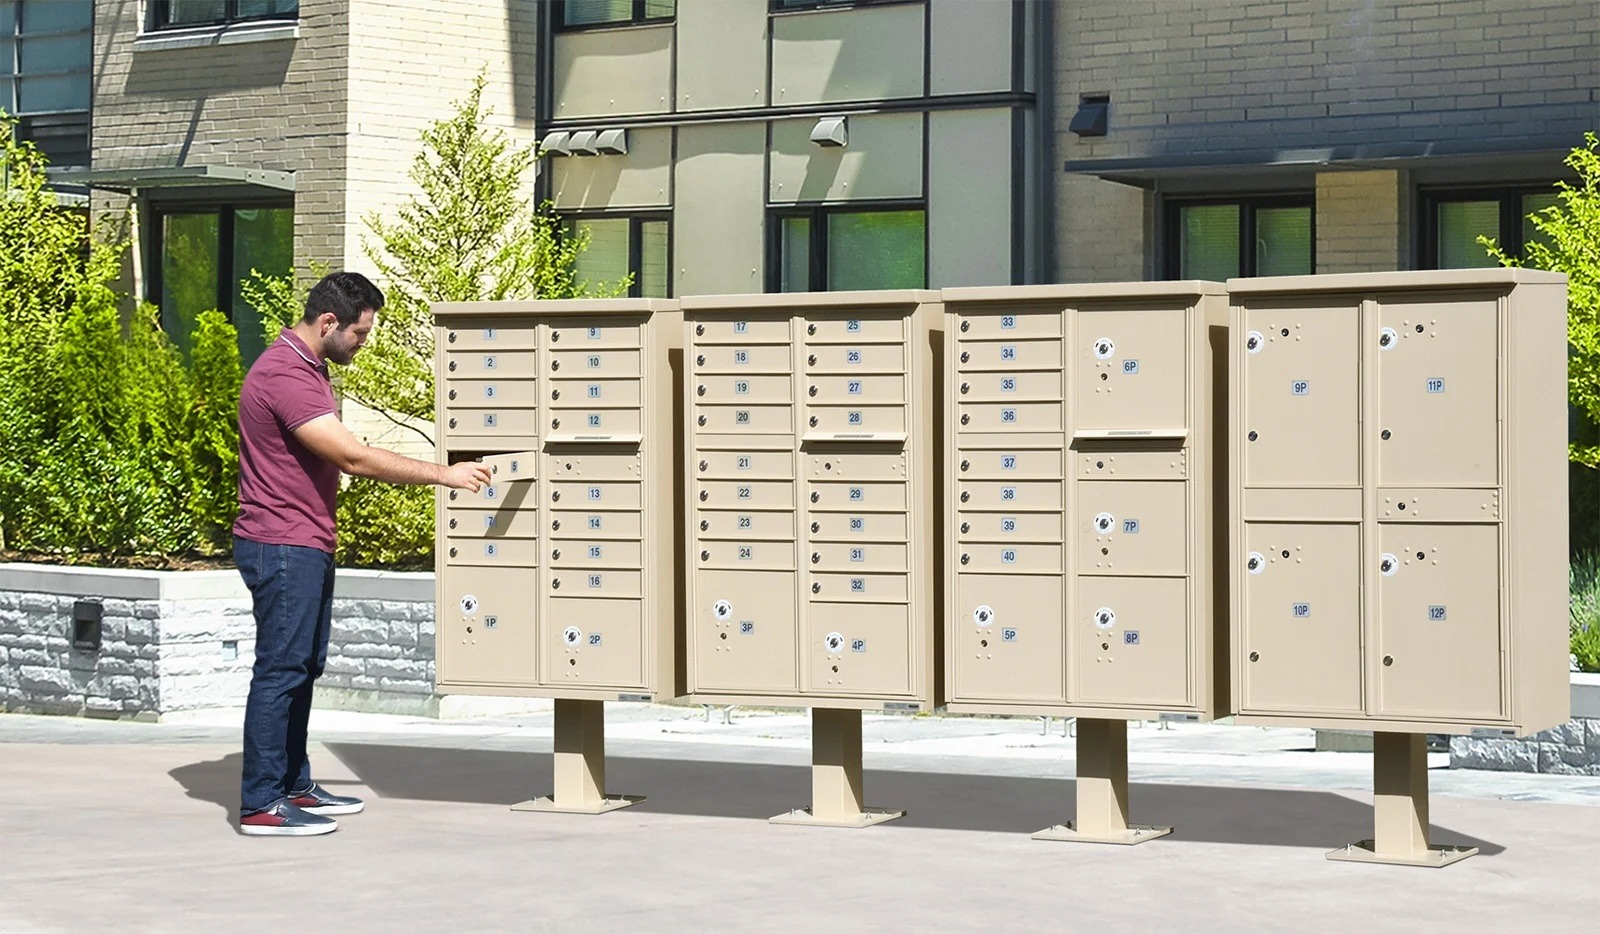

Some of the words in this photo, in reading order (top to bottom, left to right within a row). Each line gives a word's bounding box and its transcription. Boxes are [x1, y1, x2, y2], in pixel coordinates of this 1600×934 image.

[848, 321, 858, 330] 25
[1003, 317, 1013, 326] 33
[736, 323, 746, 331] 17
[488, 329, 492, 337] 1
[590, 328, 596, 336] 9
[736, 353, 746, 361] 18
[848, 353, 859, 361] 26
[1003, 349, 1013, 358] 34
[488, 358, 493, 367] 2
[590, 358, 599, 367] 10
[1124, 362, 1136, 371] 6P
[737, 383, 747, 392] 19
[849, 383, 859, 392] 27
[1003, 380, 1013, 389] 35
[1295, 382, 1306, 393] 9P
[1428, 381, 1442, 391] 11P
[488, 388, 493, 396] 3
[488, 416, 493, 424] 4
[738, 413, 748, 421] 20
[849, 414, 860, 422] 28
[1003, 412, 1014, 420] 36
[589, 416, 599, 425] 12
[512, 462, 516, 471] 5
[739, 459, 748, 467] 21
[1004, 458, 1015, 467] 37
[488, 489, 493, 497] 6
[590, 489, 600, 498] 13
[739, 489, 749, 498] 22
[851, 490, 861, 498] 29
[1003, 490, 1014, 499] 38
[488, 517, 493, 525] 7
[590, 519, 600, 527] 14
[740, 518, 750, 526] 23
[851, 520, 861, 528] 30
[1004, 521, 1015, 530] 39
[1125, 522, 1136, 531] 7P
[488, 546, 493, 554] 8
[590, 548, 600, 556] 15
[740, 549, 750, 557] 24
[852, 551, 861, 559] 31
[1004, 552, 1015, 561] 40
[590, 577, 600, 585] 16
[852, 581, 862, 589] 32
[1294, 605, 1308, 615] 10P
[1430, 608, 1444, 618] 12P
[486, 618, 496, 627] 1P
[742, 623, 752, 631] 3P
[1004, 631, 1016, 639] 5P
[1126, 634, 1138, 643] 8P
[590, 636, 601, 644] 2P
[852, 641, 863, 649] 4P
